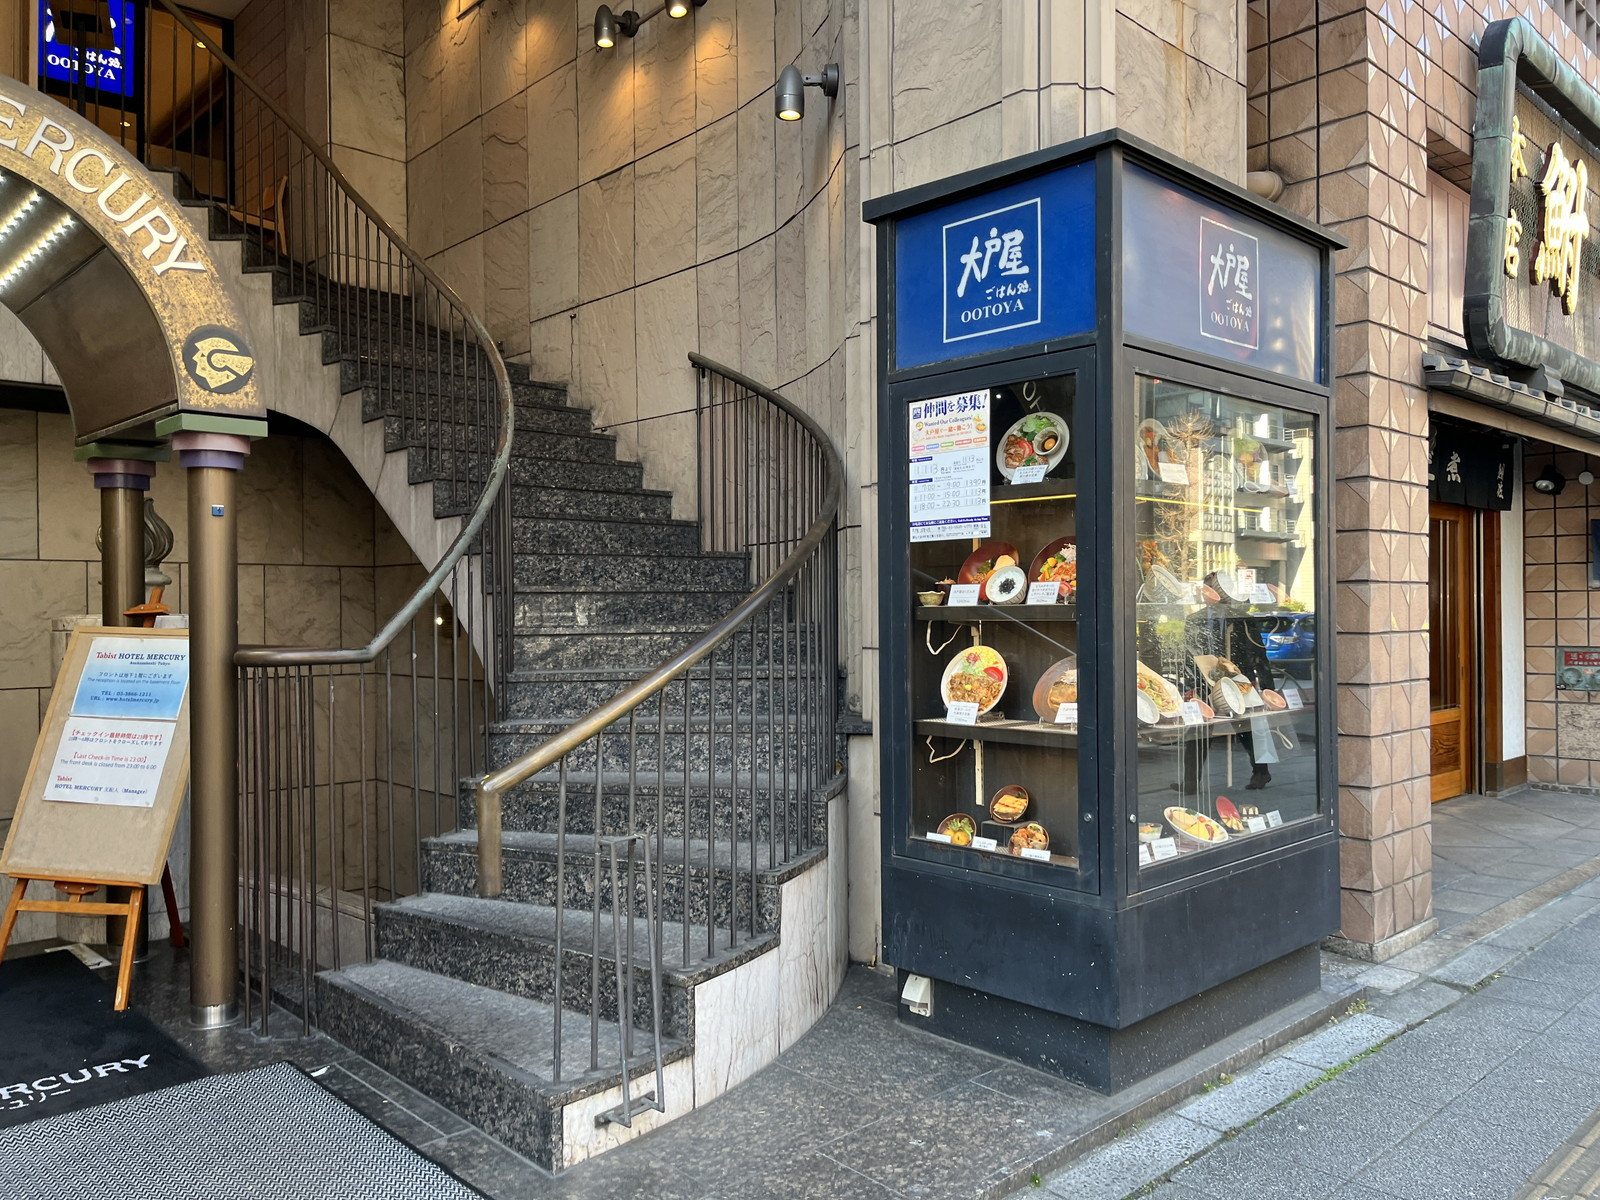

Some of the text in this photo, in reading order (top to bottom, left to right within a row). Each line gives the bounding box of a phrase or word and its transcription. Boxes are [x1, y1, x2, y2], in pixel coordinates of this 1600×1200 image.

[957, 227, 1030, 298] 大戸屋
[1207, 243, 1252, 301] 大戸屋
[961, 298, 1025, 324] OOTOYA
[1210, 311, 1250, 333] OOTOYA
[147, 653, 186, 661] MERCURY
[0, 1054, 151, 1100] RCURY
